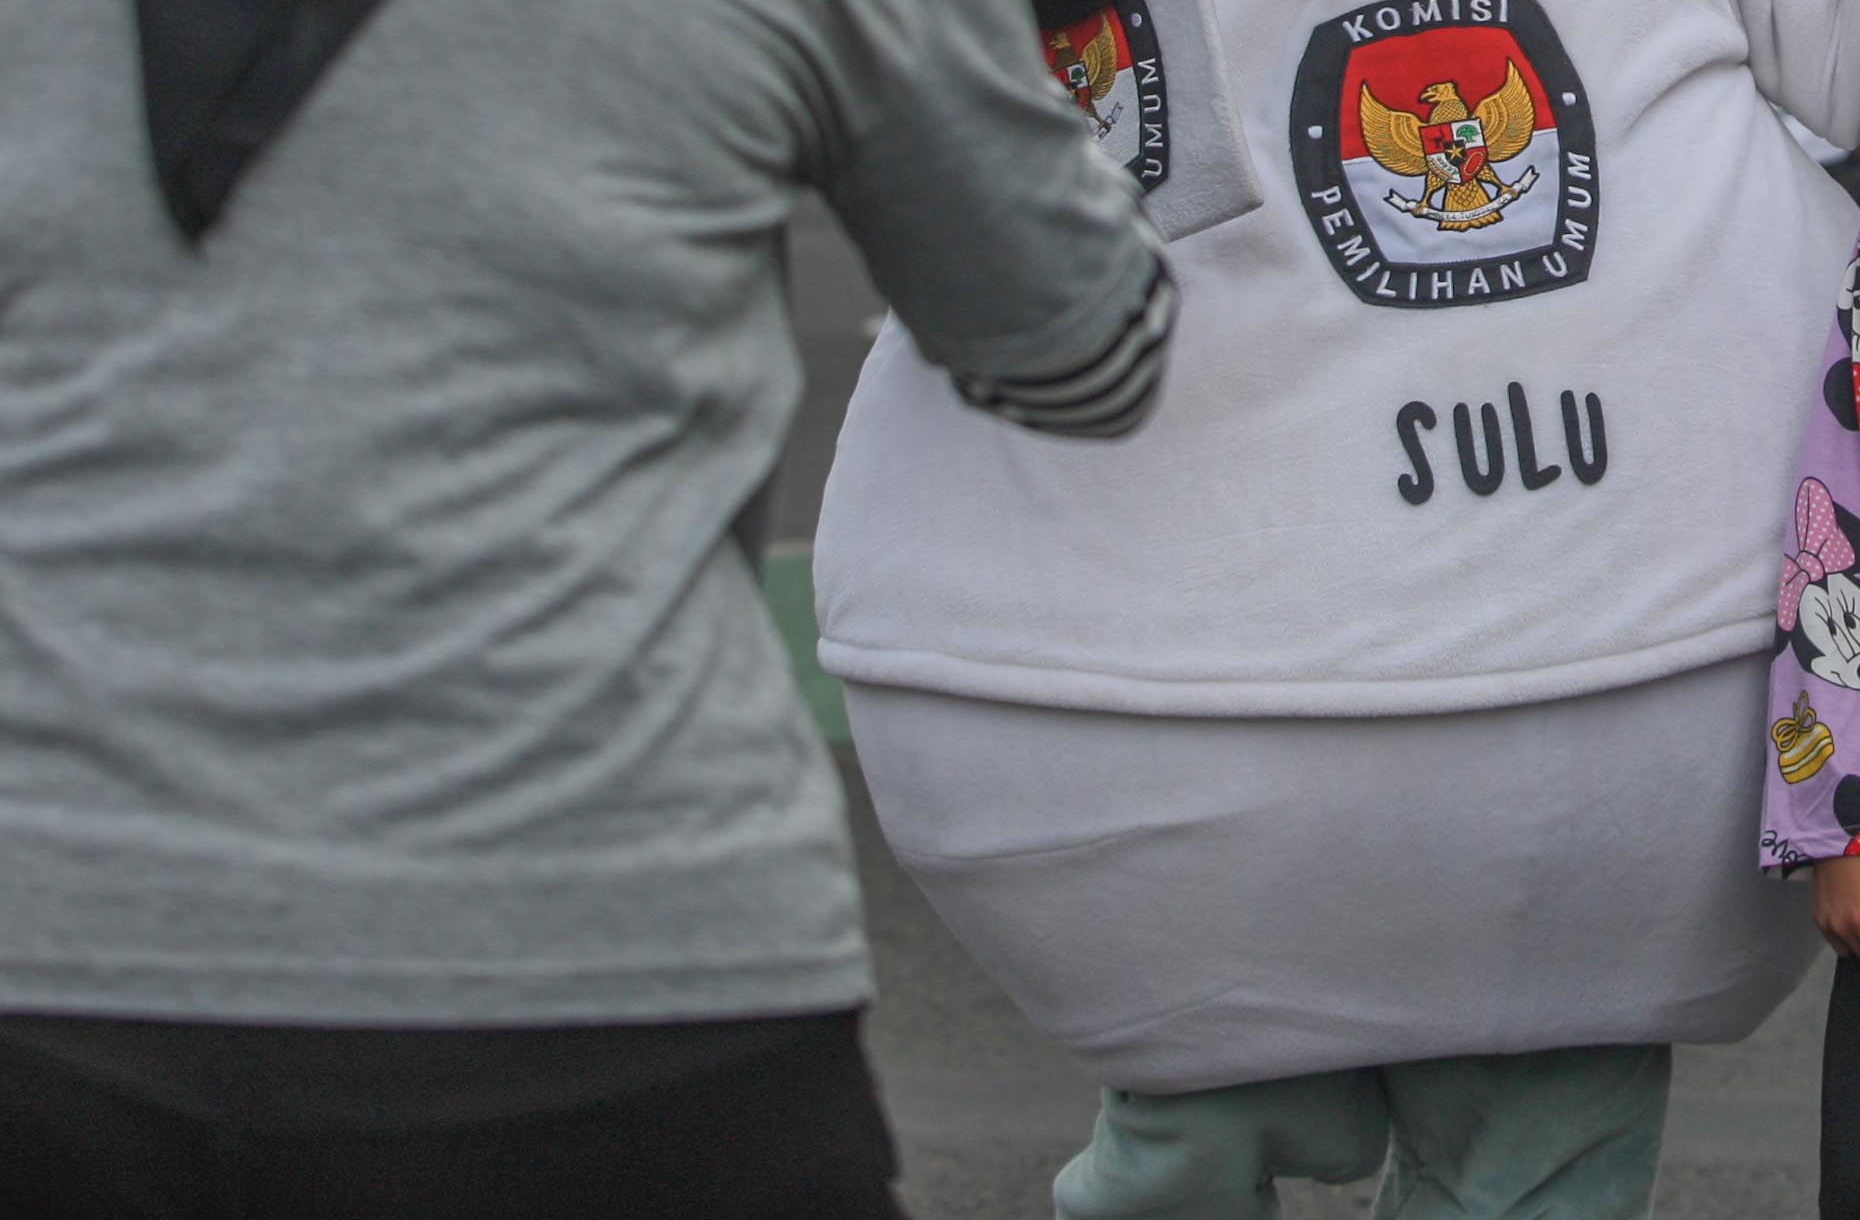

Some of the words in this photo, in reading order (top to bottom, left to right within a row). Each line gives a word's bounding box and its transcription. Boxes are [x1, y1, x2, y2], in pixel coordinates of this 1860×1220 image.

[1138, 58, 1163, 178] UMUM
[1311, 185, 1525, 300] PEMILIHAN
[1542, 153, 1593, 278] UMUM
[1396, 380, 1609, 504] SULU
